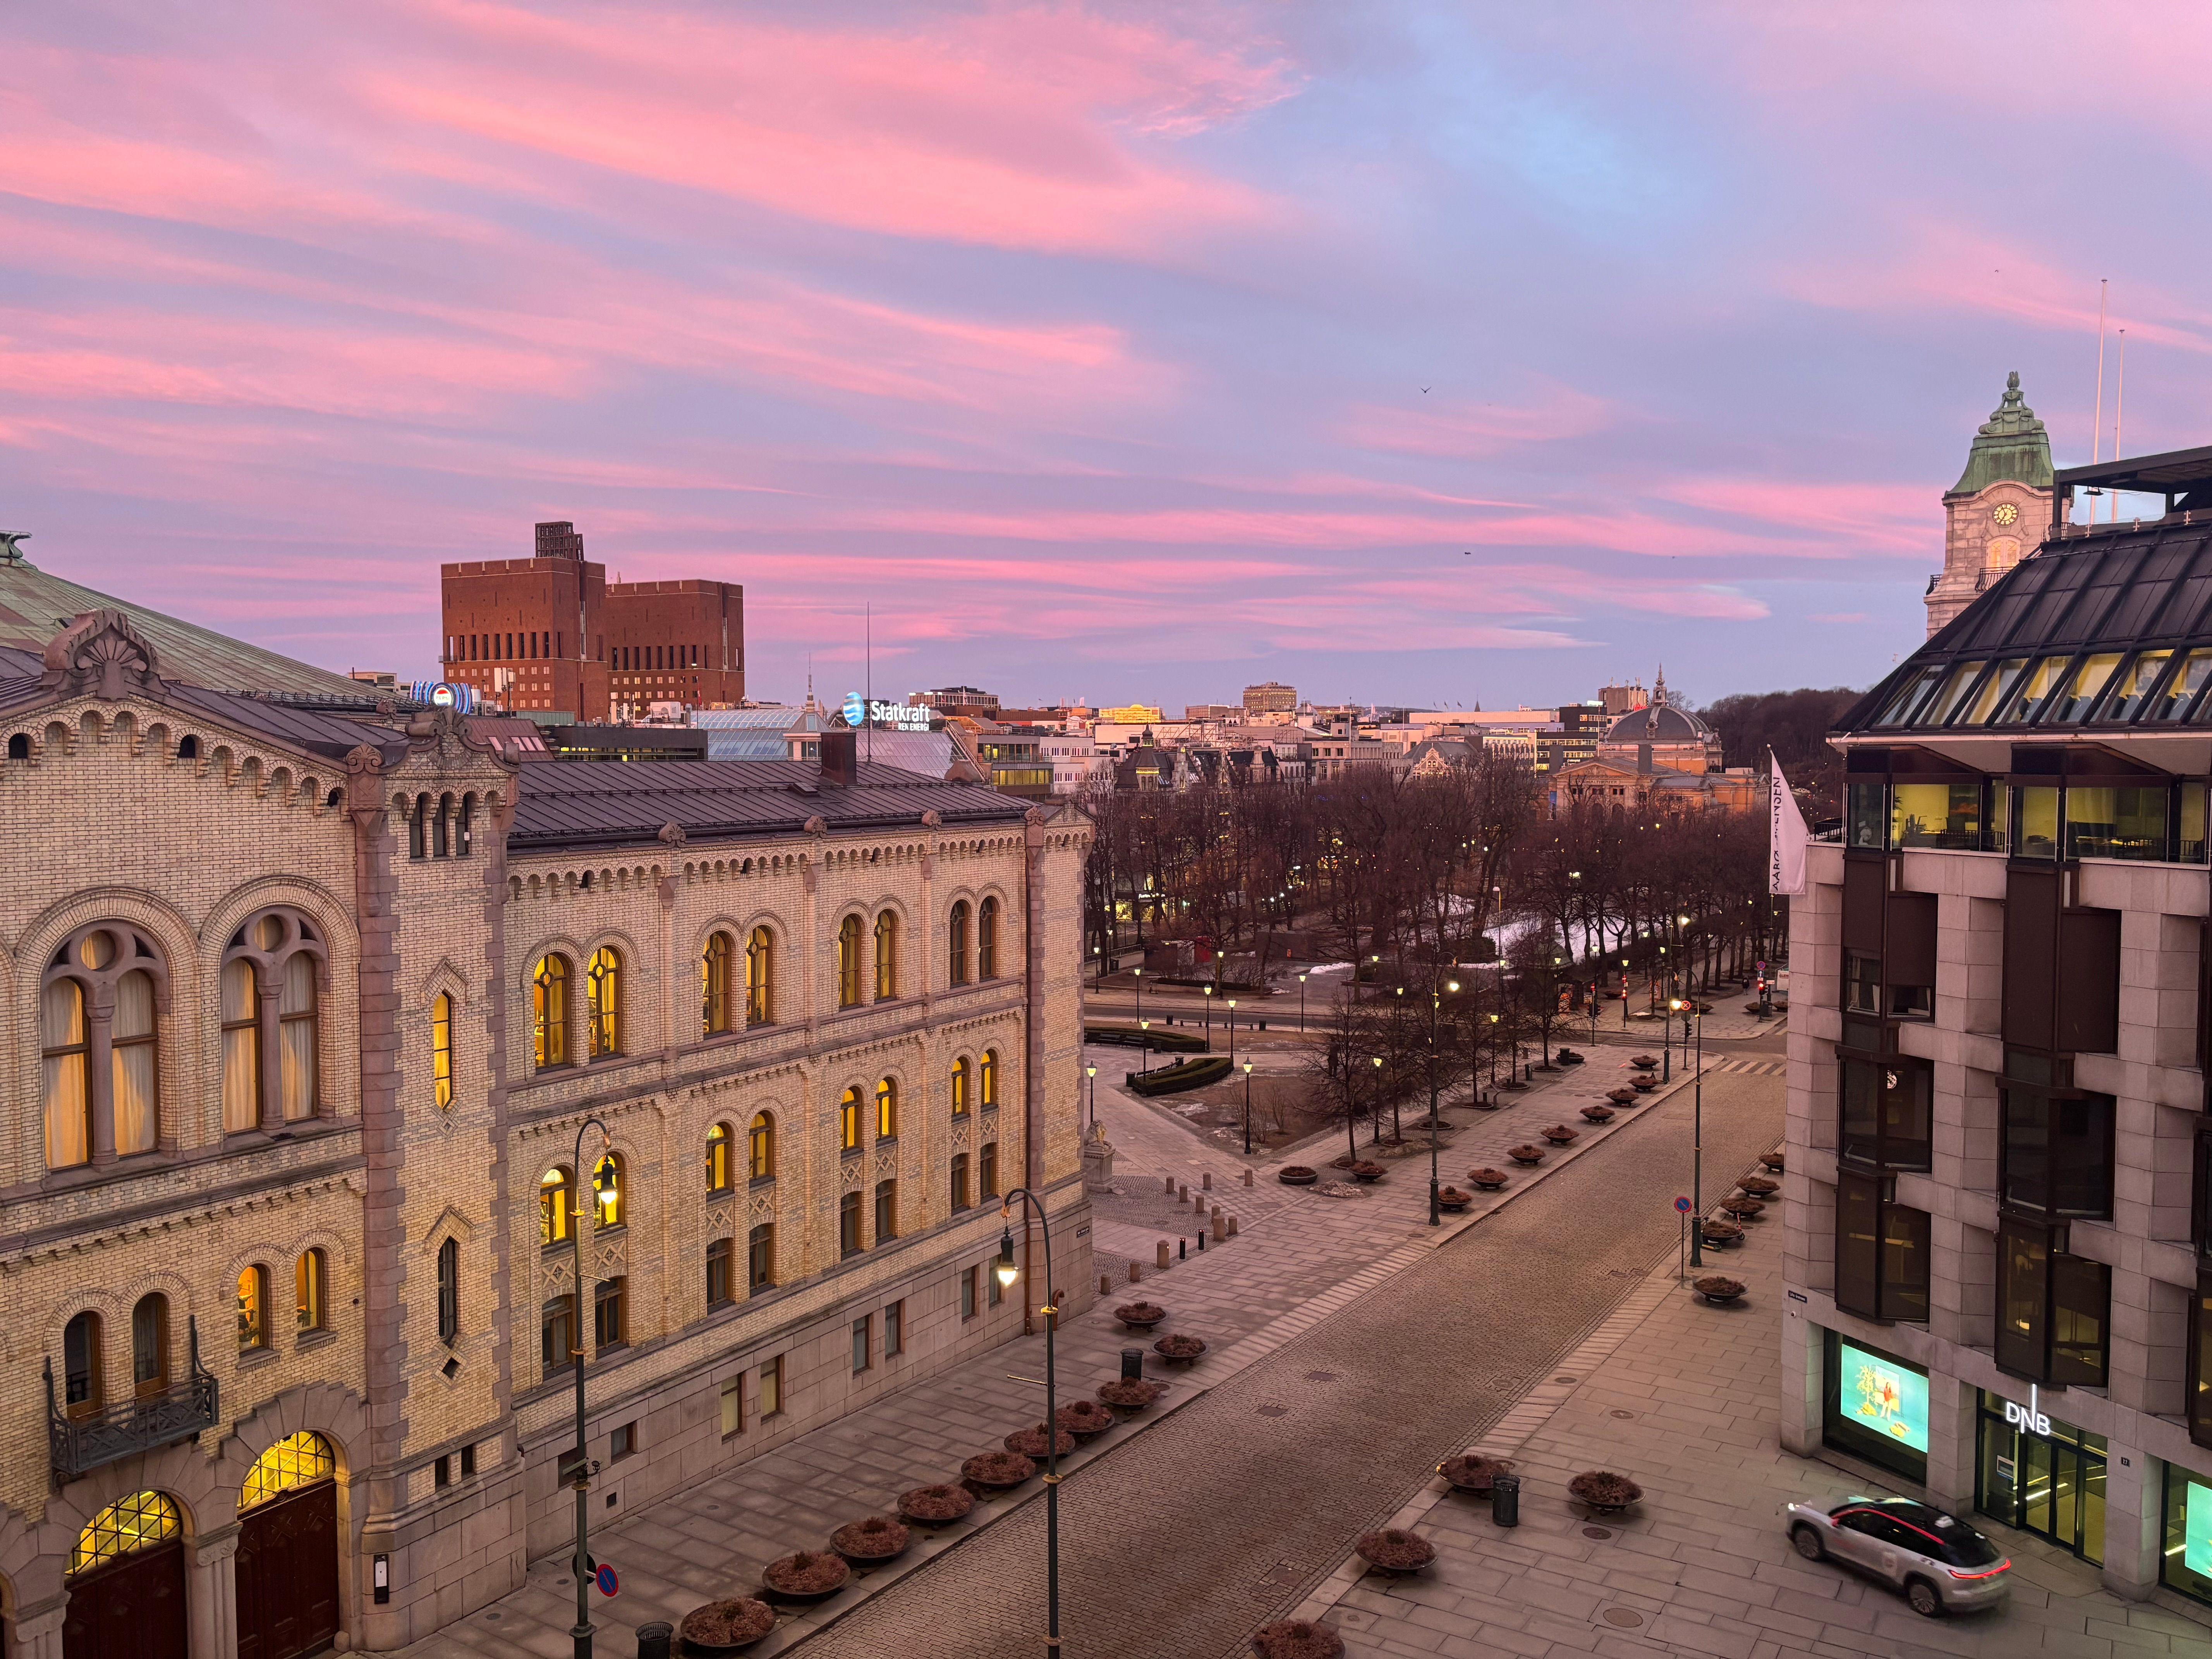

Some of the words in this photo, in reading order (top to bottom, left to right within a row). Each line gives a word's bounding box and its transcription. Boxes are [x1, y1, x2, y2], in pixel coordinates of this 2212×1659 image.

[871, 701, 930, 722] Statkraft
[898, 722, 908, 731] REN
[910, 723, 929, 731] ENERGI
[2006, 1384, 2050, 1436] DNB
